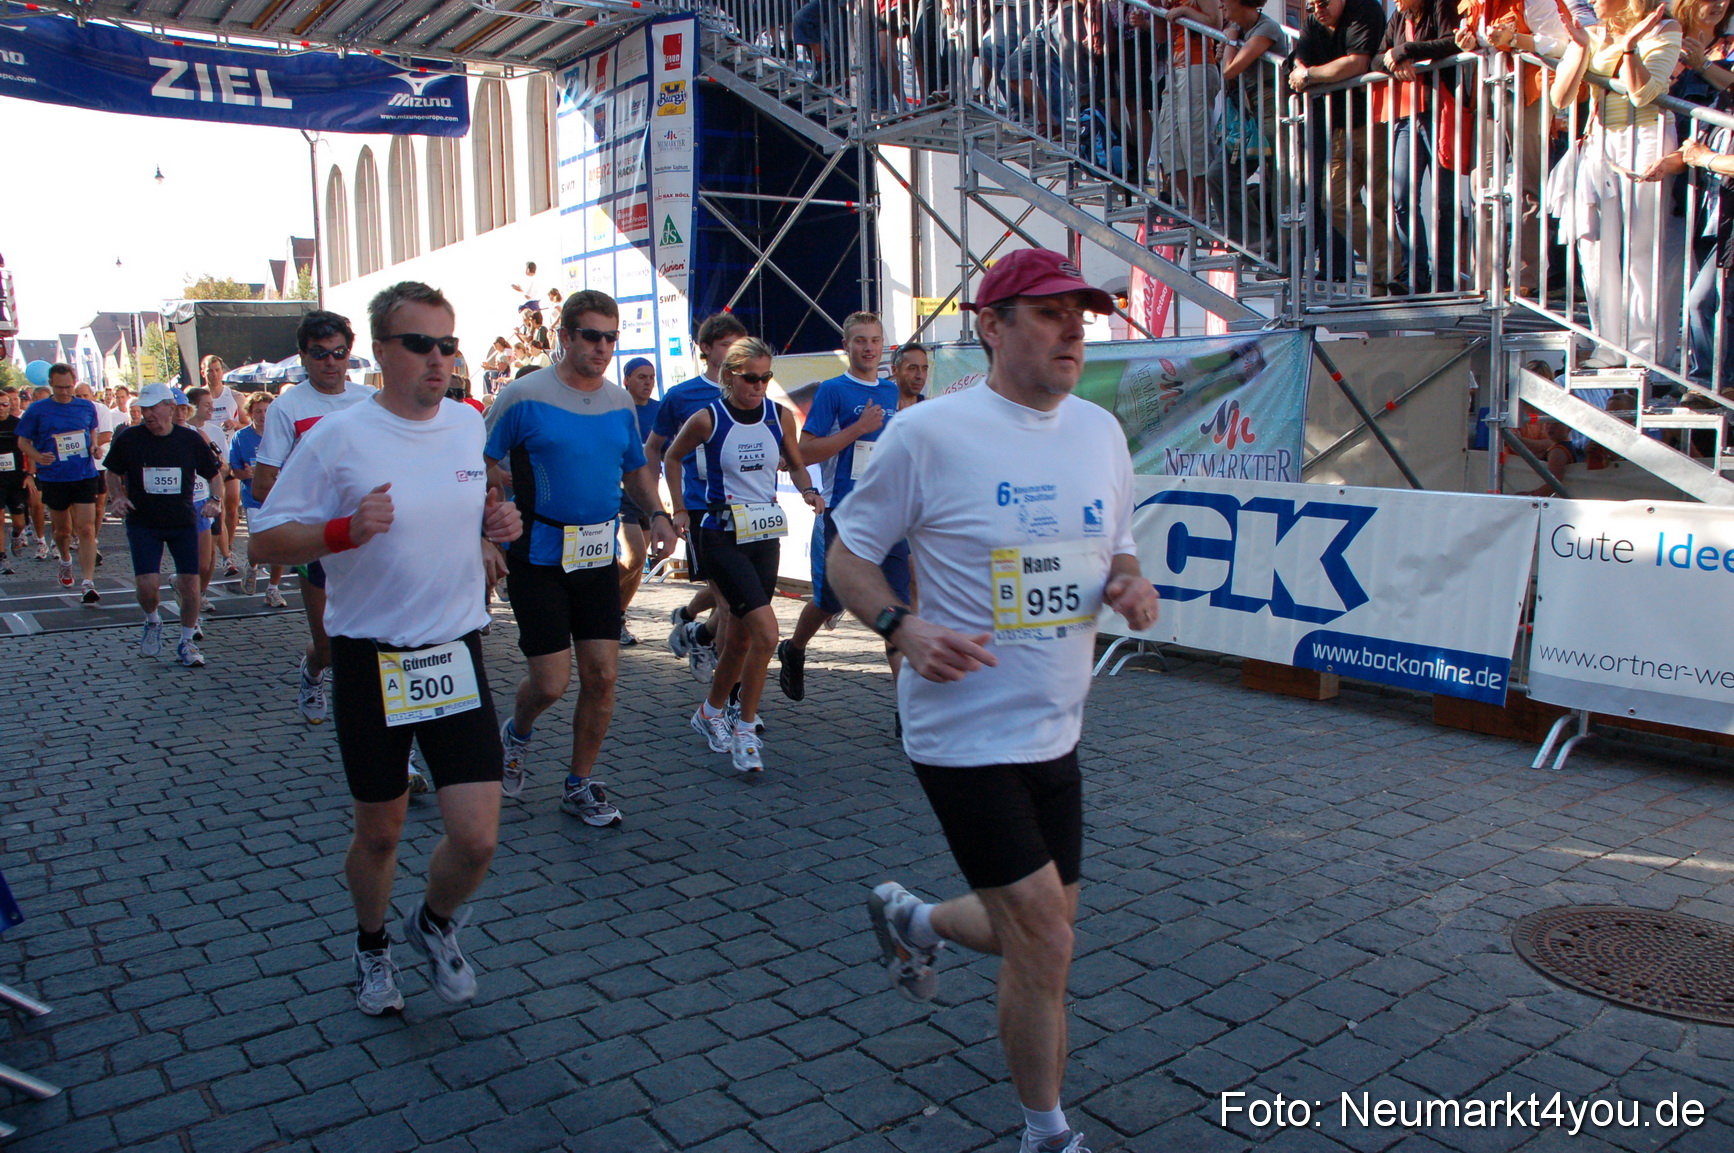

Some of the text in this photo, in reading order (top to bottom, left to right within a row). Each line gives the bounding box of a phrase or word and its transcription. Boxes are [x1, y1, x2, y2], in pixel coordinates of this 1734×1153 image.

[148, 57, 293, 109] ZIEL
[380, 114, 459, 122] www.mizunoeurope.com
[65, 442, 80, 450] 860
[1165, 448, 1291, 483] NEUMARKTER
[154, 476, 178, 486] 3551
[751, 515, 783, 531] 1059
[581, 529, 603, 537] Werner
[579, 541, 609, 557] 1061
[1551, 523, 1634, 563] Gute
[1022, 557, 1061, 574] Hans
[1000, 584, 1080, 616] B 955
[403, 652, 453, 672] Günther
[1312, 642, 1502, 690] www.bockonline.de
[388, 674, 454, 701] A 500
